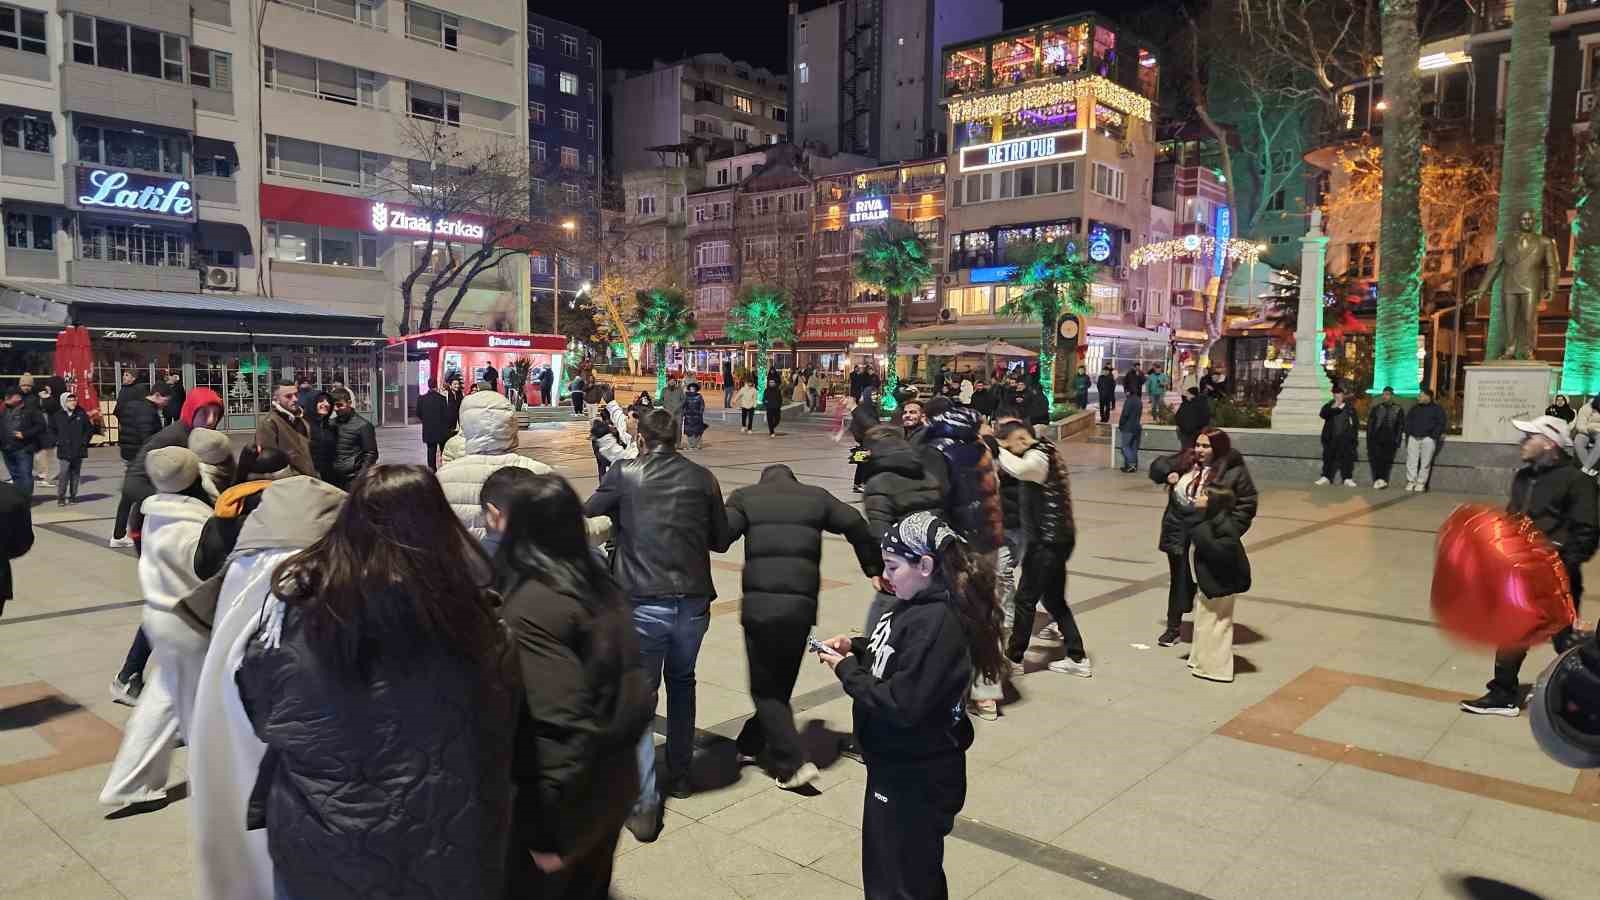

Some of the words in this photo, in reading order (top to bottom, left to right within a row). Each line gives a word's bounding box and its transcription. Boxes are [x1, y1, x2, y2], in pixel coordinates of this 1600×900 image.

[988, 142, 1027, 165] RETRO
[1030, 136, 1057, 158] PUB
[79, 169, 193, 214] Latife
[849, 213, 861, 222] ET
